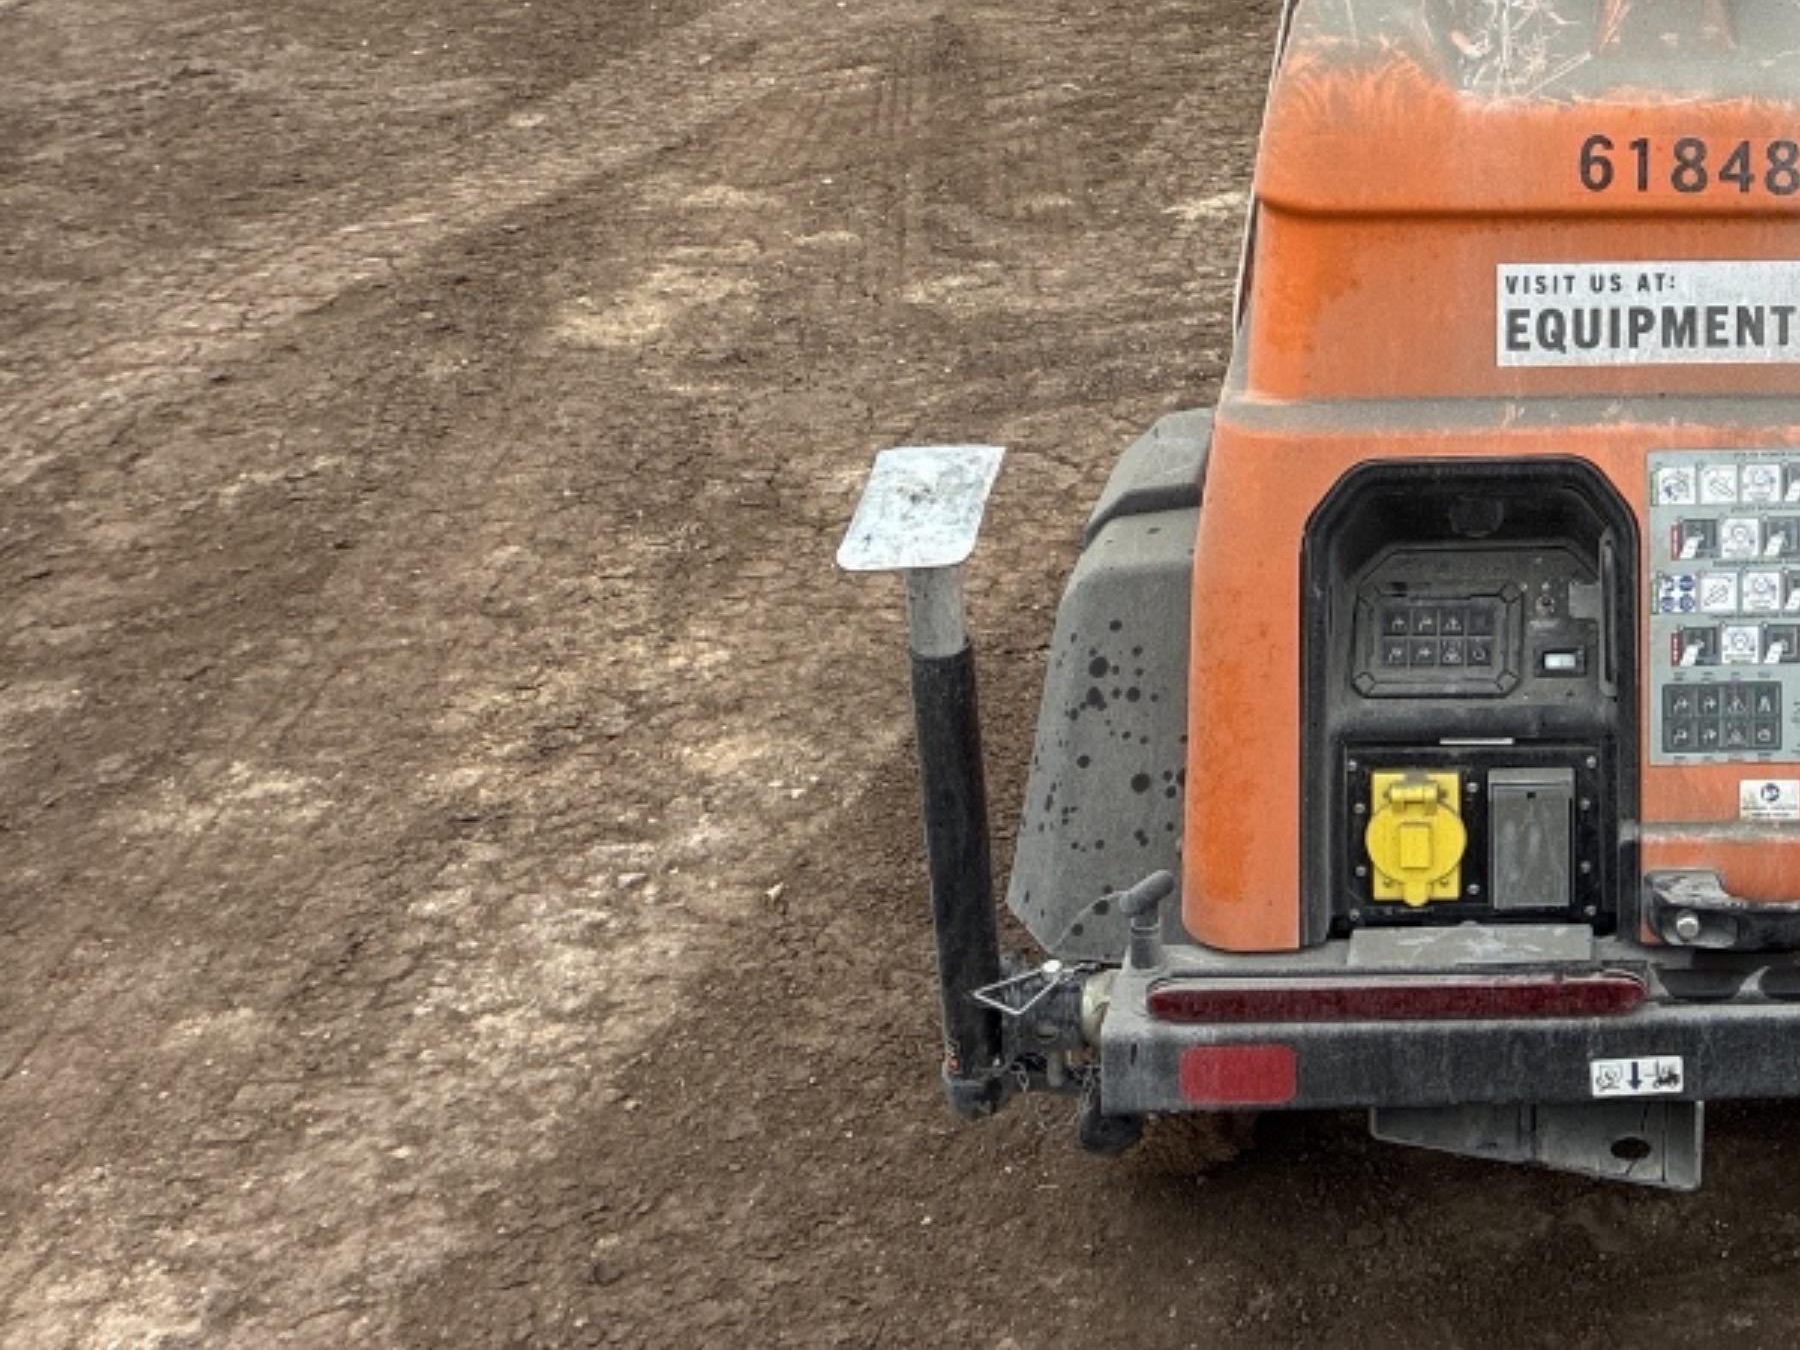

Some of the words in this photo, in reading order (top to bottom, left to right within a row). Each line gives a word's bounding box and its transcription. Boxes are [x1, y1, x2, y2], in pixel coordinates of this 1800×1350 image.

[1505, 274, 1576, 295] VISIT
[1590, 274, 1623, 293] US
[1637, 273, 1676, 293] AT:
